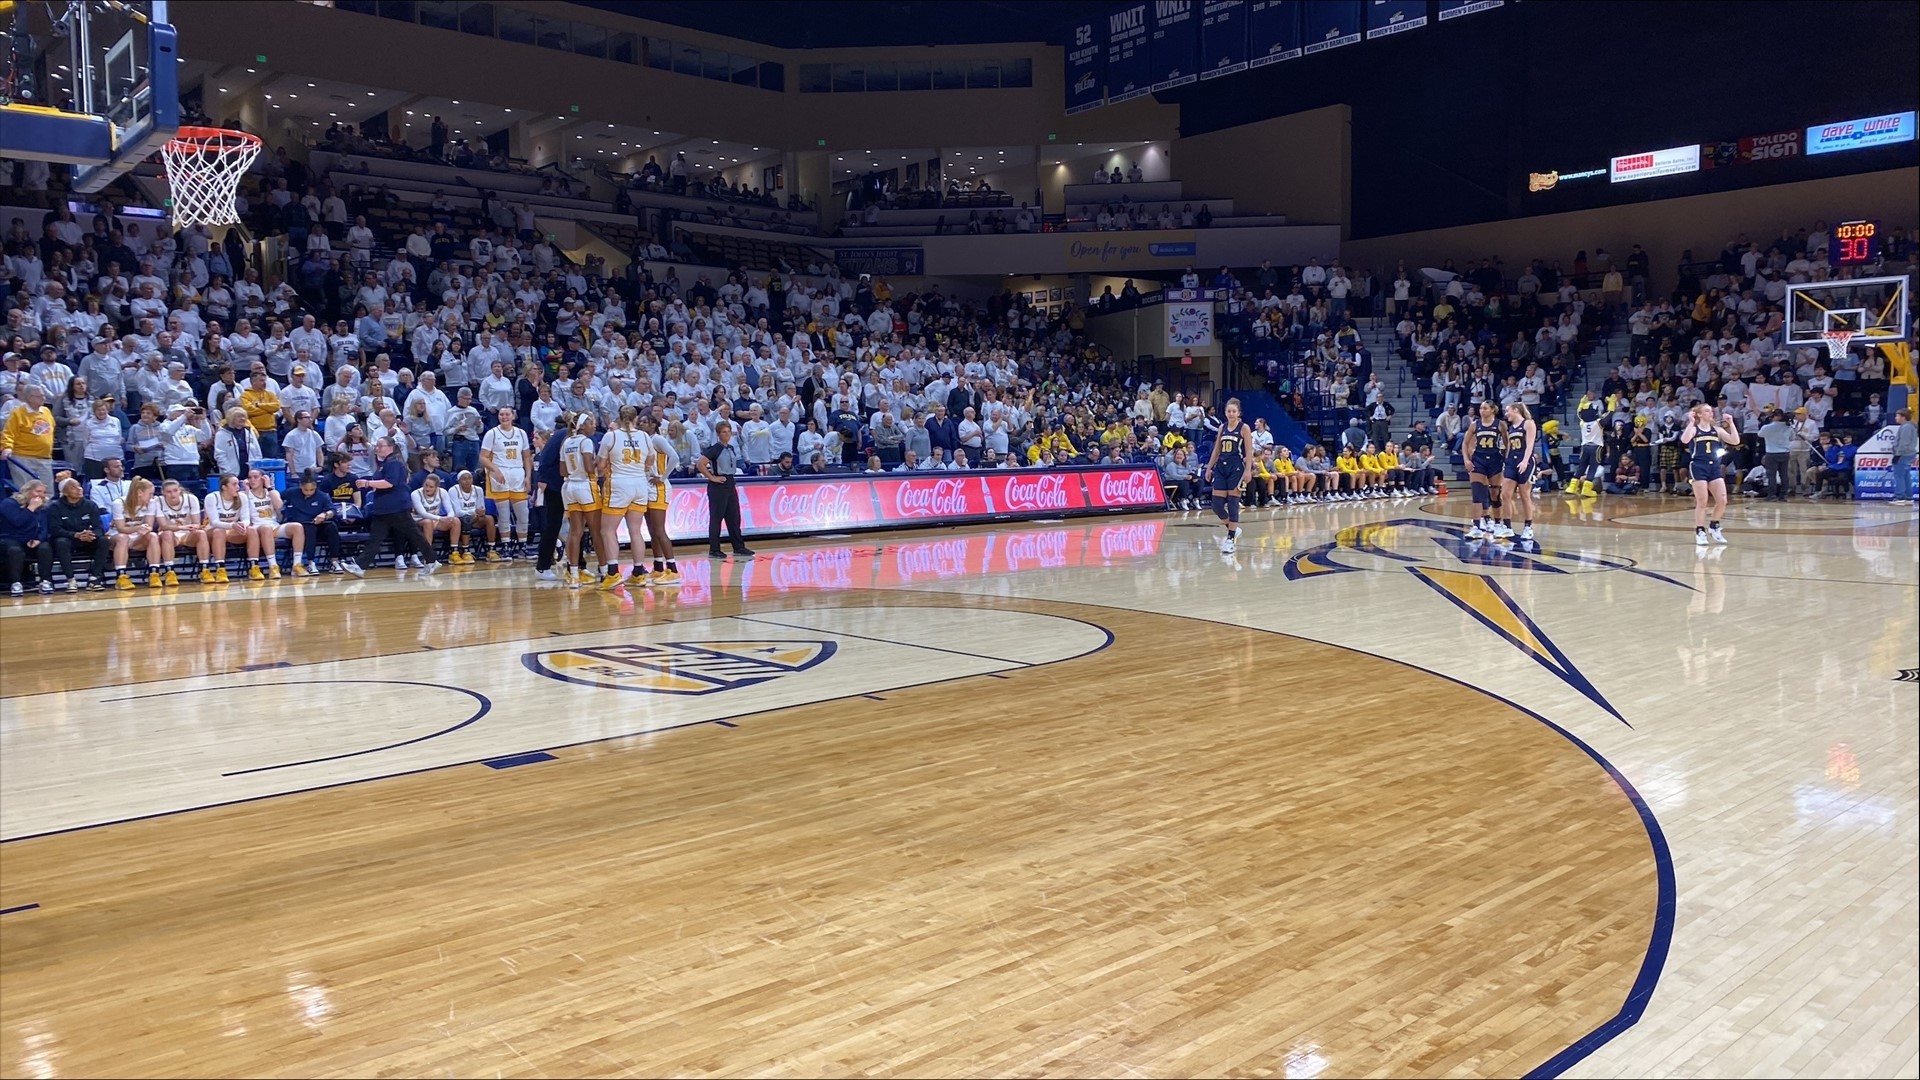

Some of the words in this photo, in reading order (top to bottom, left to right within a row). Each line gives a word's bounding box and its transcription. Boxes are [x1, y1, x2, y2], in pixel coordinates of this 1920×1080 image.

[1156, 0, 1191, 19] WNIT
[1110, 4, 1146, 34] WNIT
[1075, 24, 1092, 46] 52
[1822, 124, 1854, 138] dave
[1864, 117, 1901, 132] white
[1752, 132, 1798, 147] TOLEDO
[1751, 142, 1798, 160] SIGN
[1837, 224, 1875, 238] 10:00
[1071, 240, 1099, 259] Open
[1101, 241, 1117, 263] for
[1120, 246, 1141, 260] you
[1840, 238, 1868, 260] 30
[839, 257, 899, 274] TITANS
[1586, 424, 1592, 433] 5
[1221, 440, 1233, 453] 10
[1479, 437, 1494, 449] 44
[1705, 441, 1712, 454] 1
[622, 448, 641, 465] 34
[1858, 457, 1889, 467] dave
[1005, 474, 1067, 510] Coca-Cola
[1100, 471, 1156, 505] Coca-Cola
[769, 484, 852, 525] Coca-Cola
[896, 478, 968, 517] Coca-Cola
